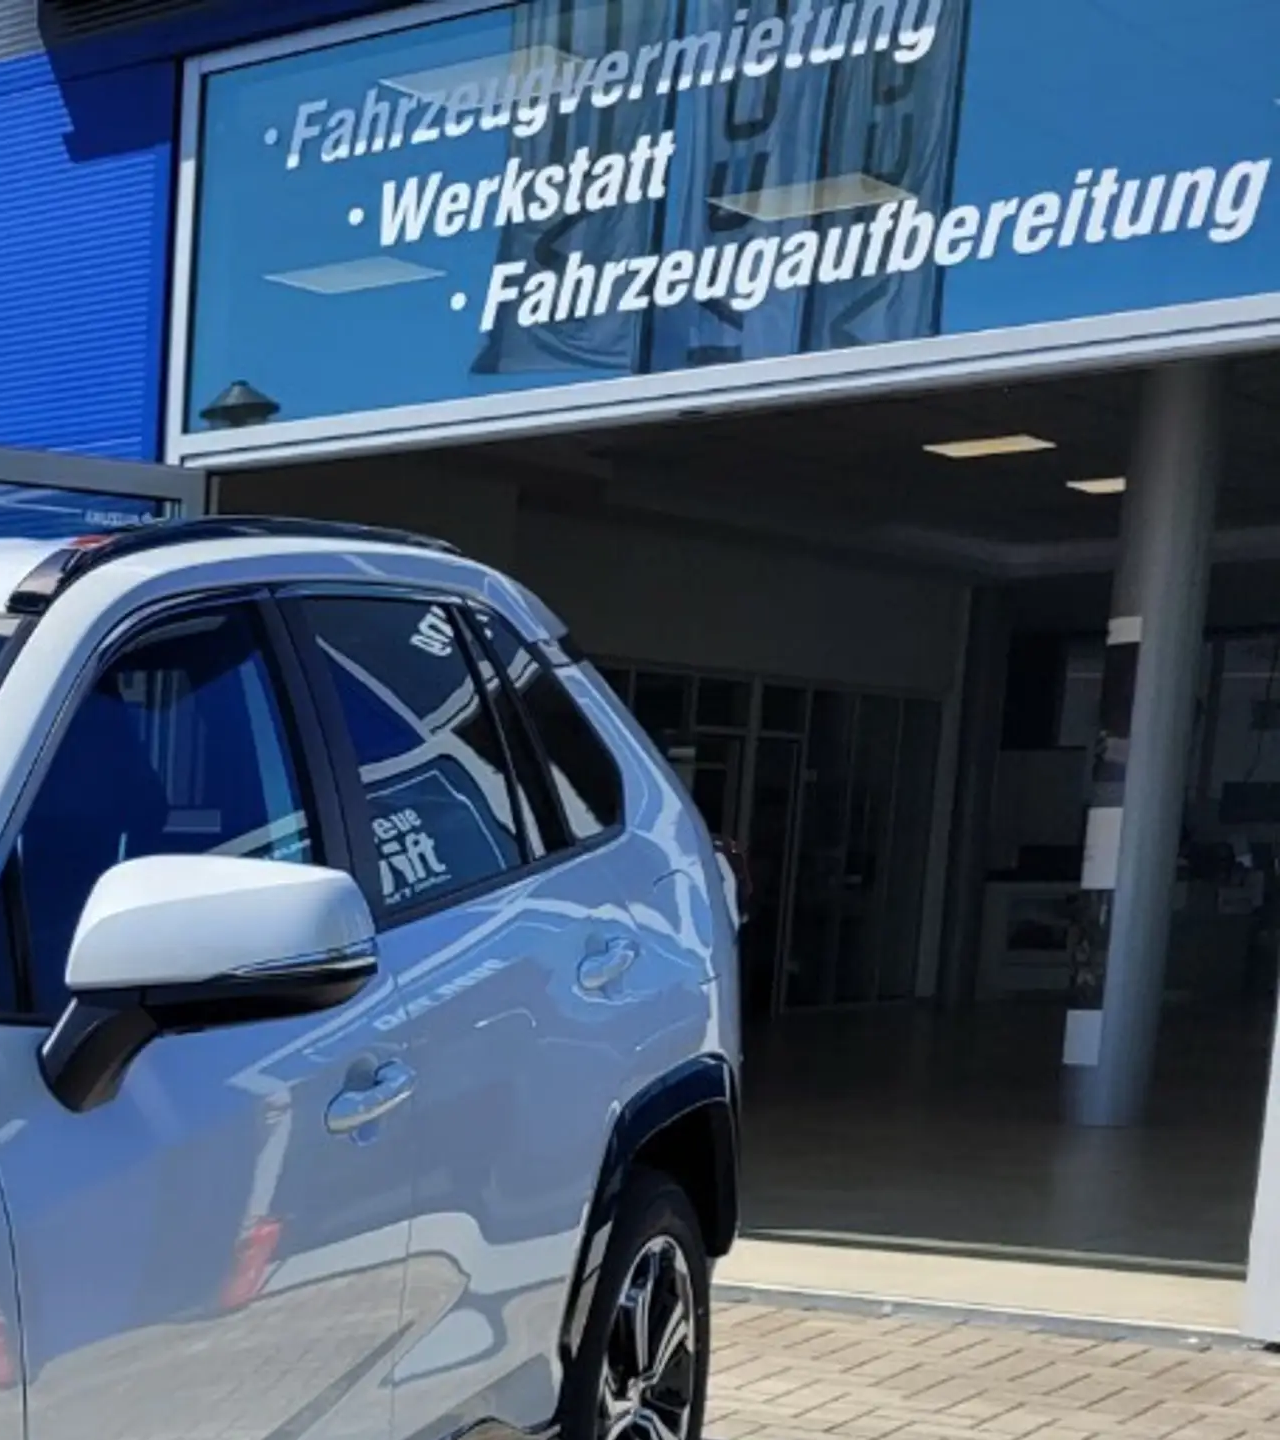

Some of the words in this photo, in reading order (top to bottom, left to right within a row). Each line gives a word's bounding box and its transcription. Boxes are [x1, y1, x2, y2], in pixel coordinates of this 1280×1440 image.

[286, 0, 941, 171] Fahrzeugvermietung
[379, 130, 675, 247] Werkstatt
[480, 158, 1271, 332] Fahrzeugaufbereitung
